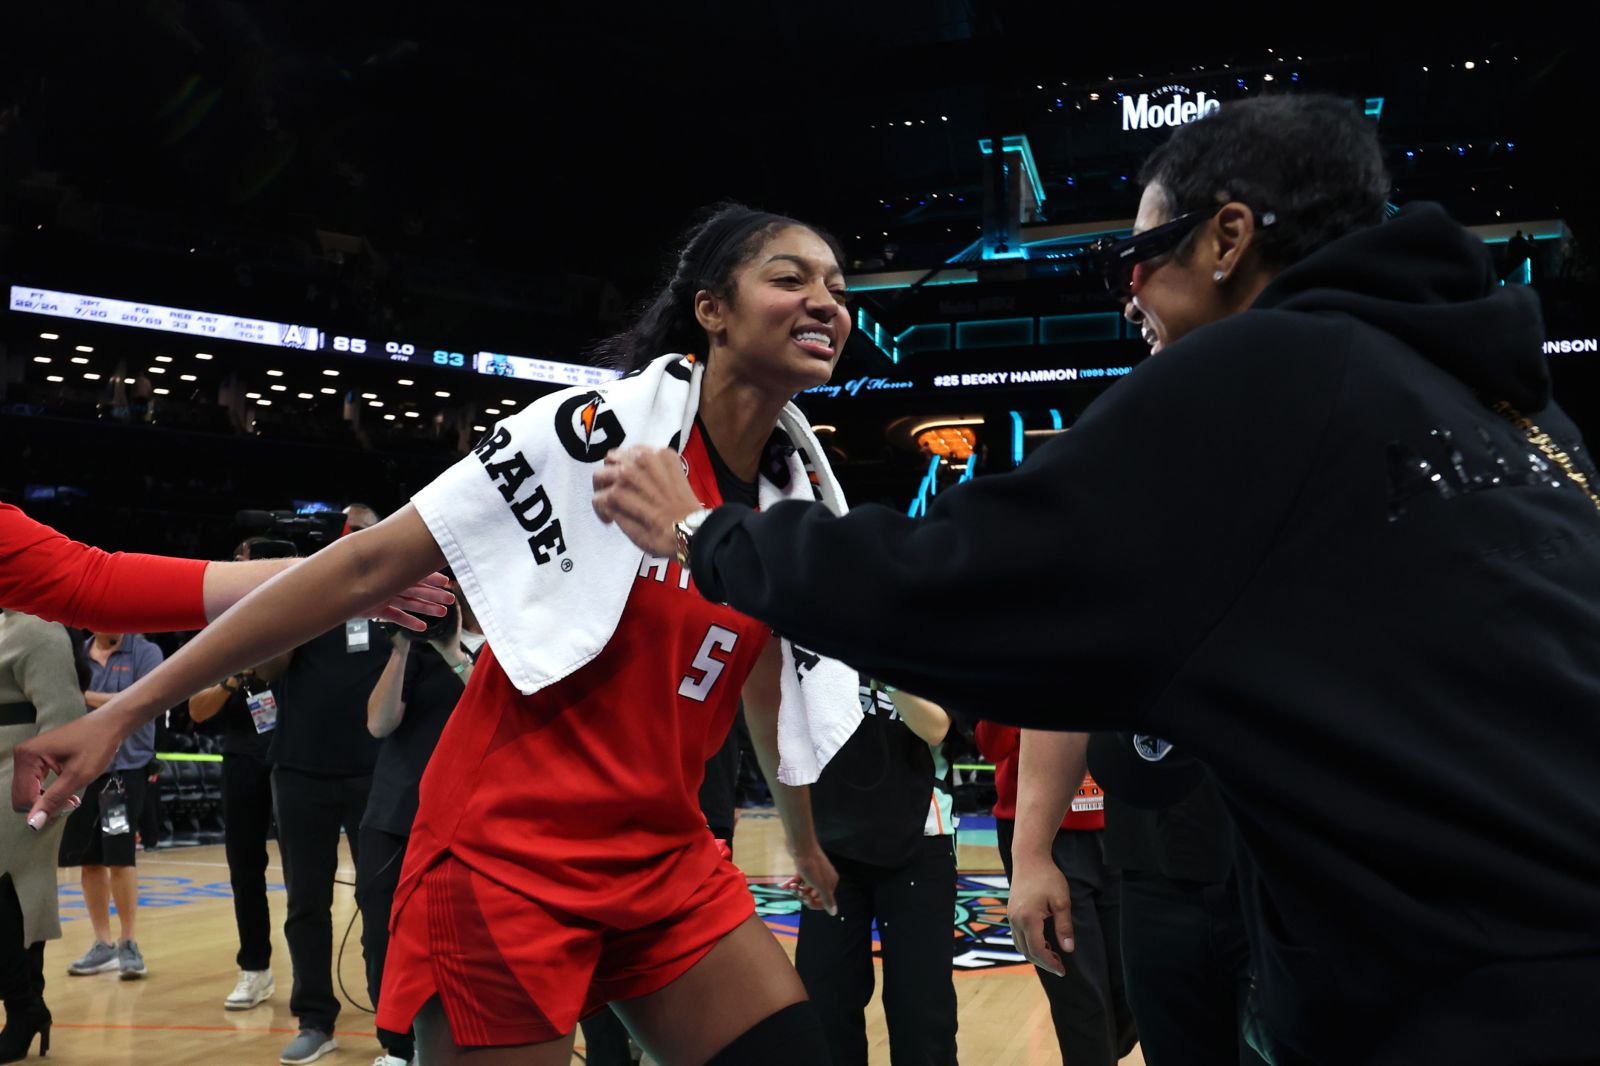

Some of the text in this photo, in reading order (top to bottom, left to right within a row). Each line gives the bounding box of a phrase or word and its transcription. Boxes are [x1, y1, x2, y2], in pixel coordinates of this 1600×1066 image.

[1151, 84, 1191, 98] CERVEZA
[1122, 91, 1221, 131] Modelo
[333, 336, 367, 354] 85
[385, 341, 415, 355] 0.0
[433, 350, 465, 367] 83
[844, 376, 869, 397] Of
[866, 377, 914, 390] Honor
[934, 374, 960, 387] #25
[961, 371, 1009, 386] BECKY
[1010, 368, 1077, 383] HAMMON
[474, 426, 567, 566] RADE
[678, 625, 738, 702] 5
